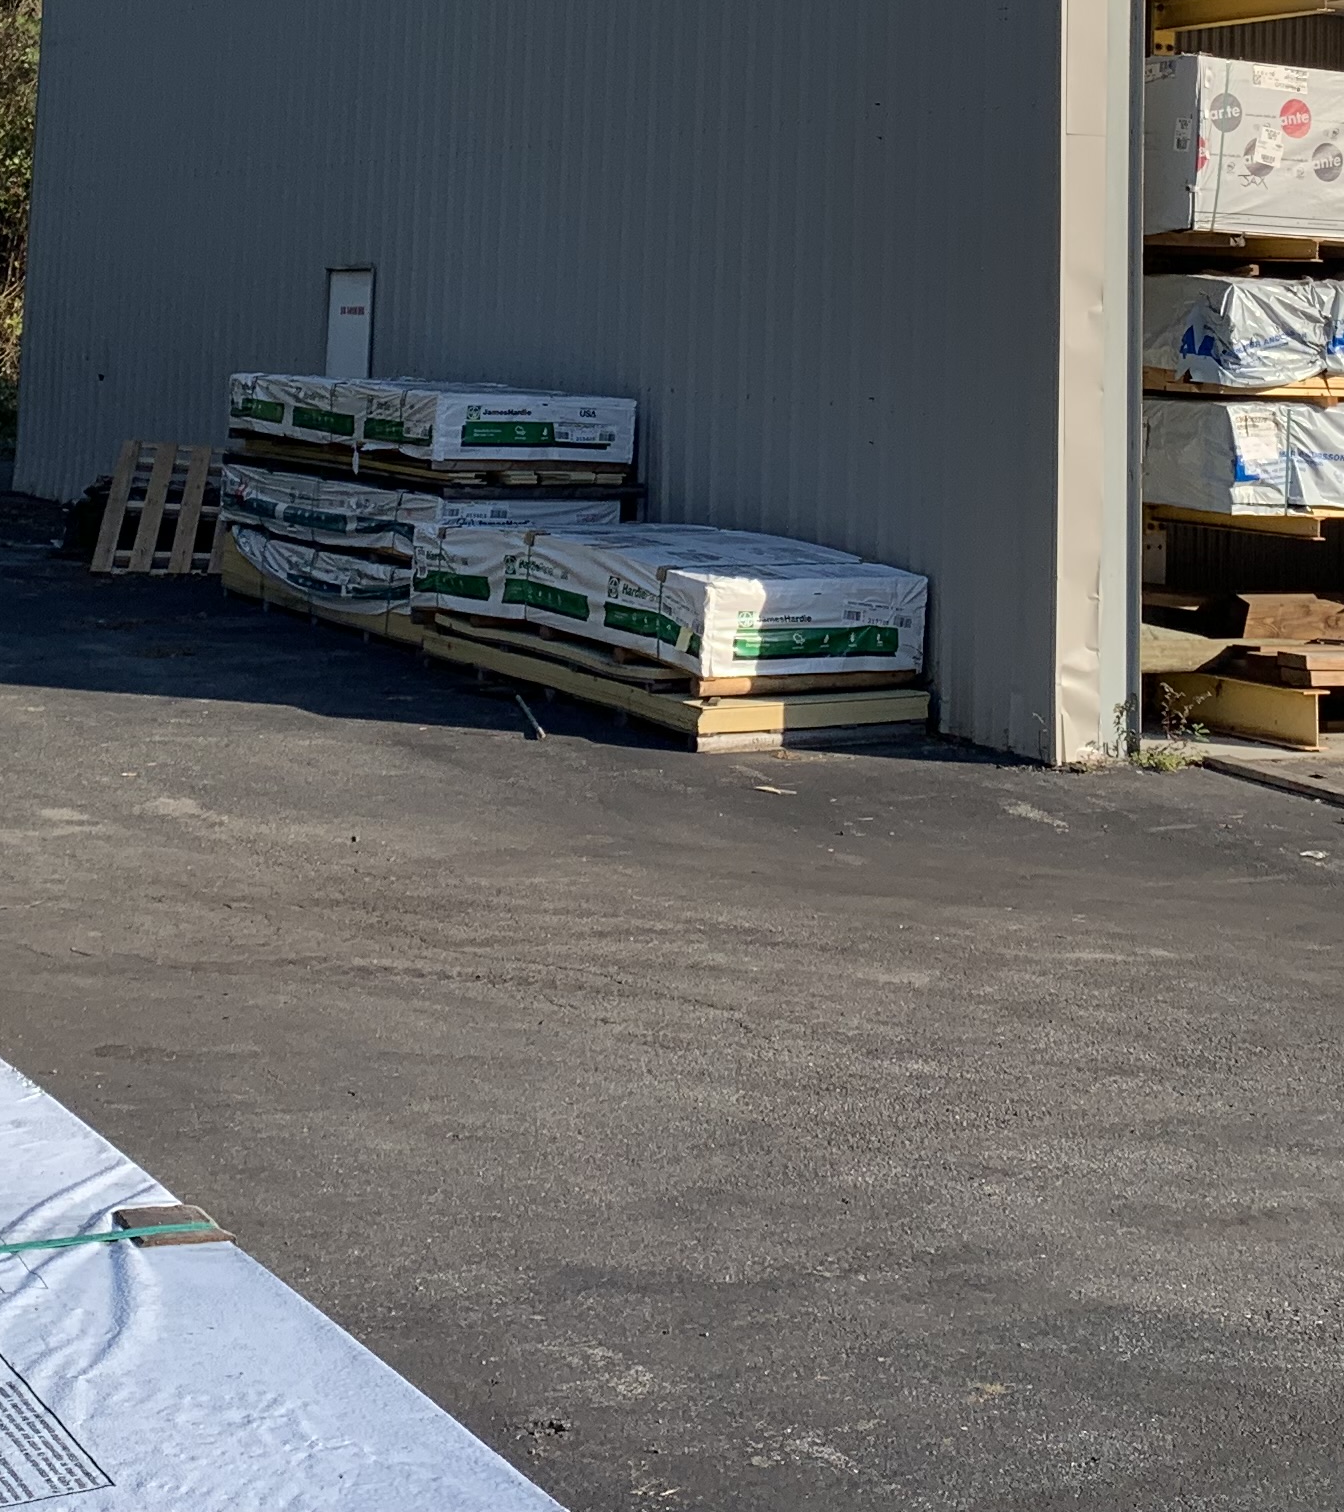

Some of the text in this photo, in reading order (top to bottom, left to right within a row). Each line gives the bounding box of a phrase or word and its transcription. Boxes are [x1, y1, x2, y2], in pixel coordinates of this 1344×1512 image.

[1280, 110, 1310, 127] ante
[1312, 153, 1342, 169] ante
[482, 407, 532, 417] JamesHardie
[579, 408, 597, 419] USA
